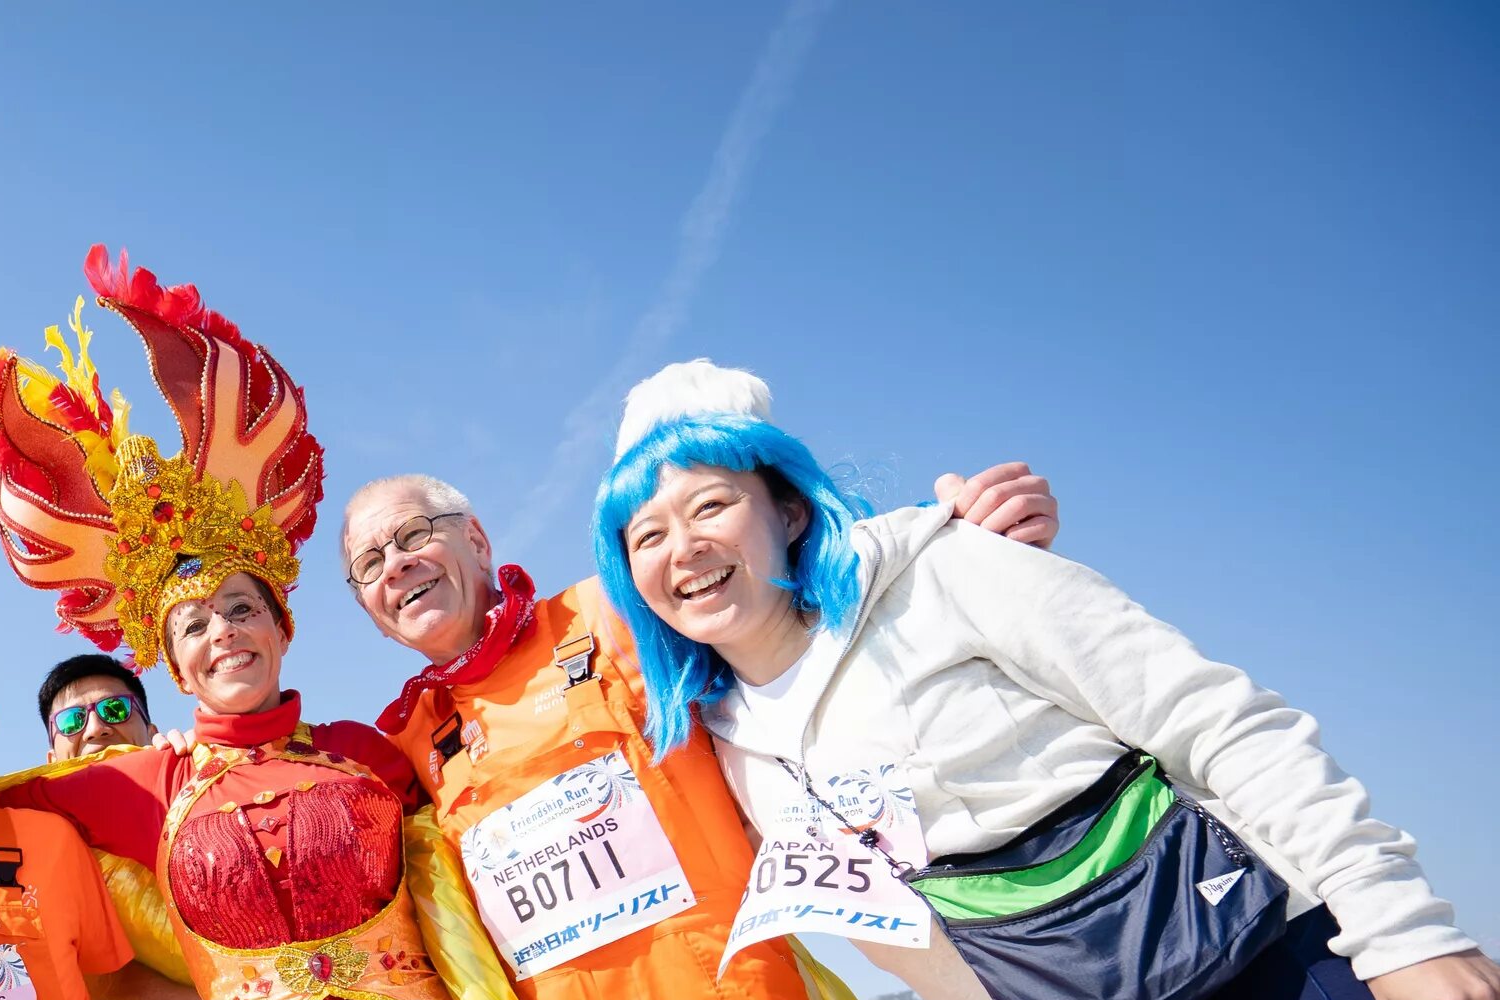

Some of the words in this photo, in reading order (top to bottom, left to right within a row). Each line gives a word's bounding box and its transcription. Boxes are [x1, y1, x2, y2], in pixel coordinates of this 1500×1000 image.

[510, 799, 565, 832] Friendship
[564, 785, 589, 802] Run
[576, 797, 593, 810] 2019
[837, 794, 860, 809] Run
[493, 817, 619, 887] NETHERLANDS
[761, 840, 835, 857] JAPAN
[505, 839, 626, 924] B0711
[740, 854, 873, 907] 0525
[513, 883, 680, 967] 近畿日本ツーリスト
